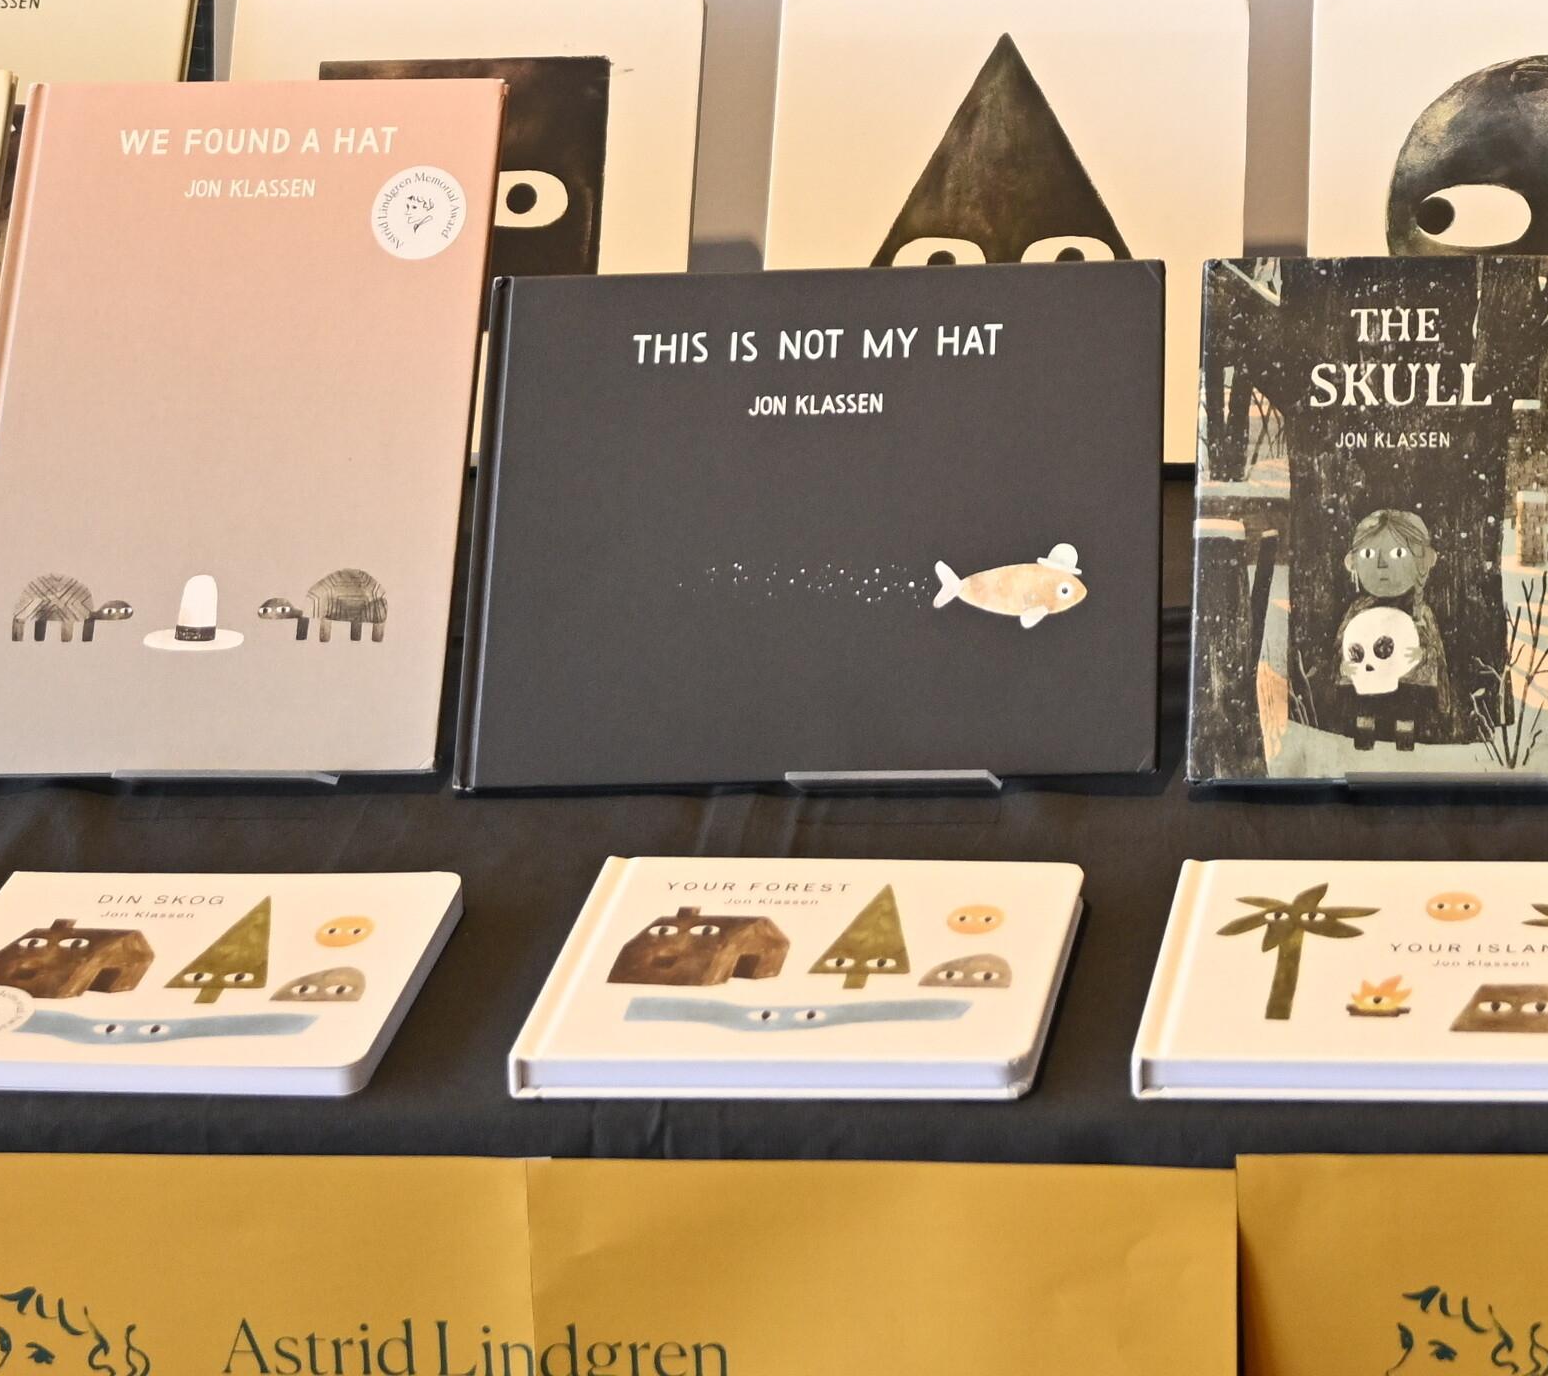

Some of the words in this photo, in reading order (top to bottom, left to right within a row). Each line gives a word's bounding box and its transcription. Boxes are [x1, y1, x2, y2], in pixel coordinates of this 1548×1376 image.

[120, 128, 170, 155] WE
[184, 127, 291, 155] FOUND
[300, 127, 320, 154] A
[333, 126, 399, 154] HAT
[184, 179, 222, 198] JON
[229, 178, 316, 199] KLASSEN
[379, 177, 412, 212] Lindgren
[415, 172, 459, 202] Memorial
[377, 216, 404, 249] Astrid
[441, 205, 460, 239] Award
[1350, 305, 1440, 343] THE
[632, 331, 709, 365] THIS
[729, 331, 758, 362] IS
[779, 328, 845, 361] NOT
[862, 327, 919, 359] MY
[937, 323, 1004, 357] HAT
[1309, 362, 1492, 408] SKULL
[748, 395, 787, 417] JON
[795, 392, 884, 415] KLASSEN
[1335, 431, 1368, 450] JON
[1374, 431, 1450, 451] KLASSEN
[97, 894, 142, 904] DIN
[154, 895, 224, 905] SKOG
[668, 882, 736, 891] YOUR
[749, 882, 851, 892] FOREST
[1391, 943, 1461, 953] YOUR
[223, 1318, 416, 1376] Astrid
[436, 1320, 727, 1376] Lindgren
